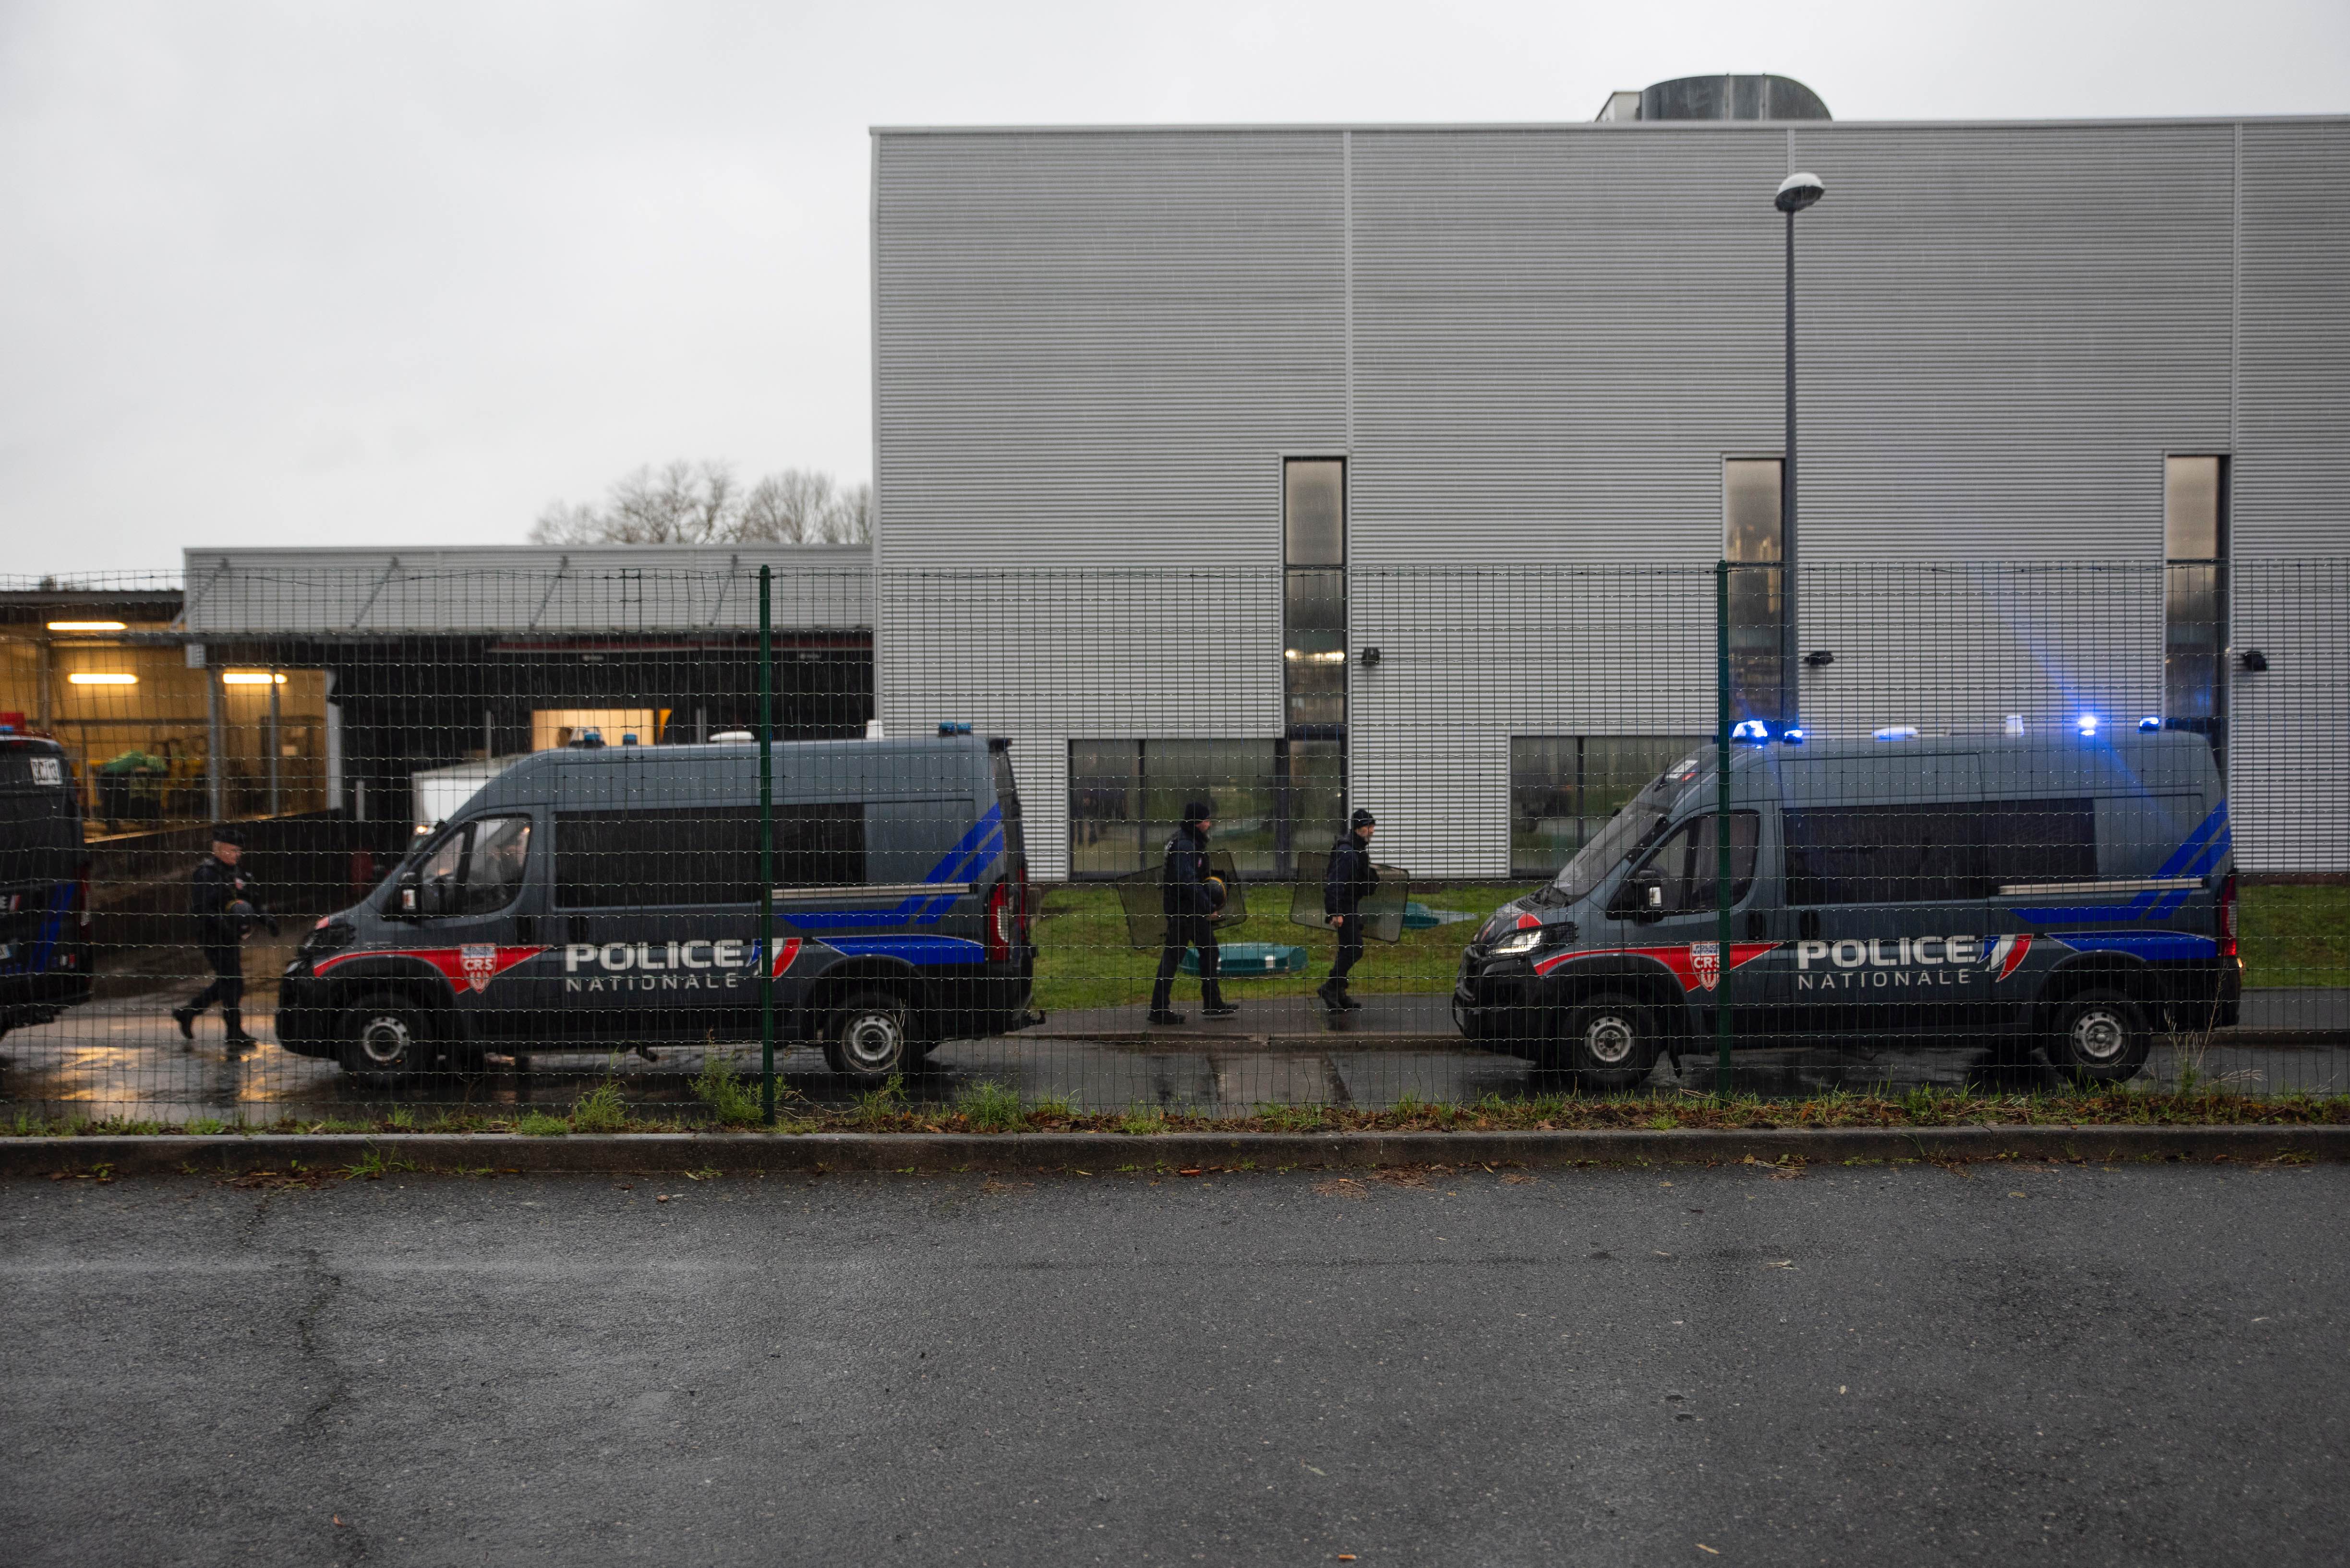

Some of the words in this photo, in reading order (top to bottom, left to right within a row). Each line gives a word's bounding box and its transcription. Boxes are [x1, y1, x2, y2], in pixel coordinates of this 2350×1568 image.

[566, 939, 744, 972] POLICE
[1694, 957, 1720, 969] CRS
[1798, 935, 1976, 970] POLICE
[463, 959, 494, 971] CRS
[566, 972, 738, 992] NATIONALE
[1798, 969, 1971, 991] NATIONALE
